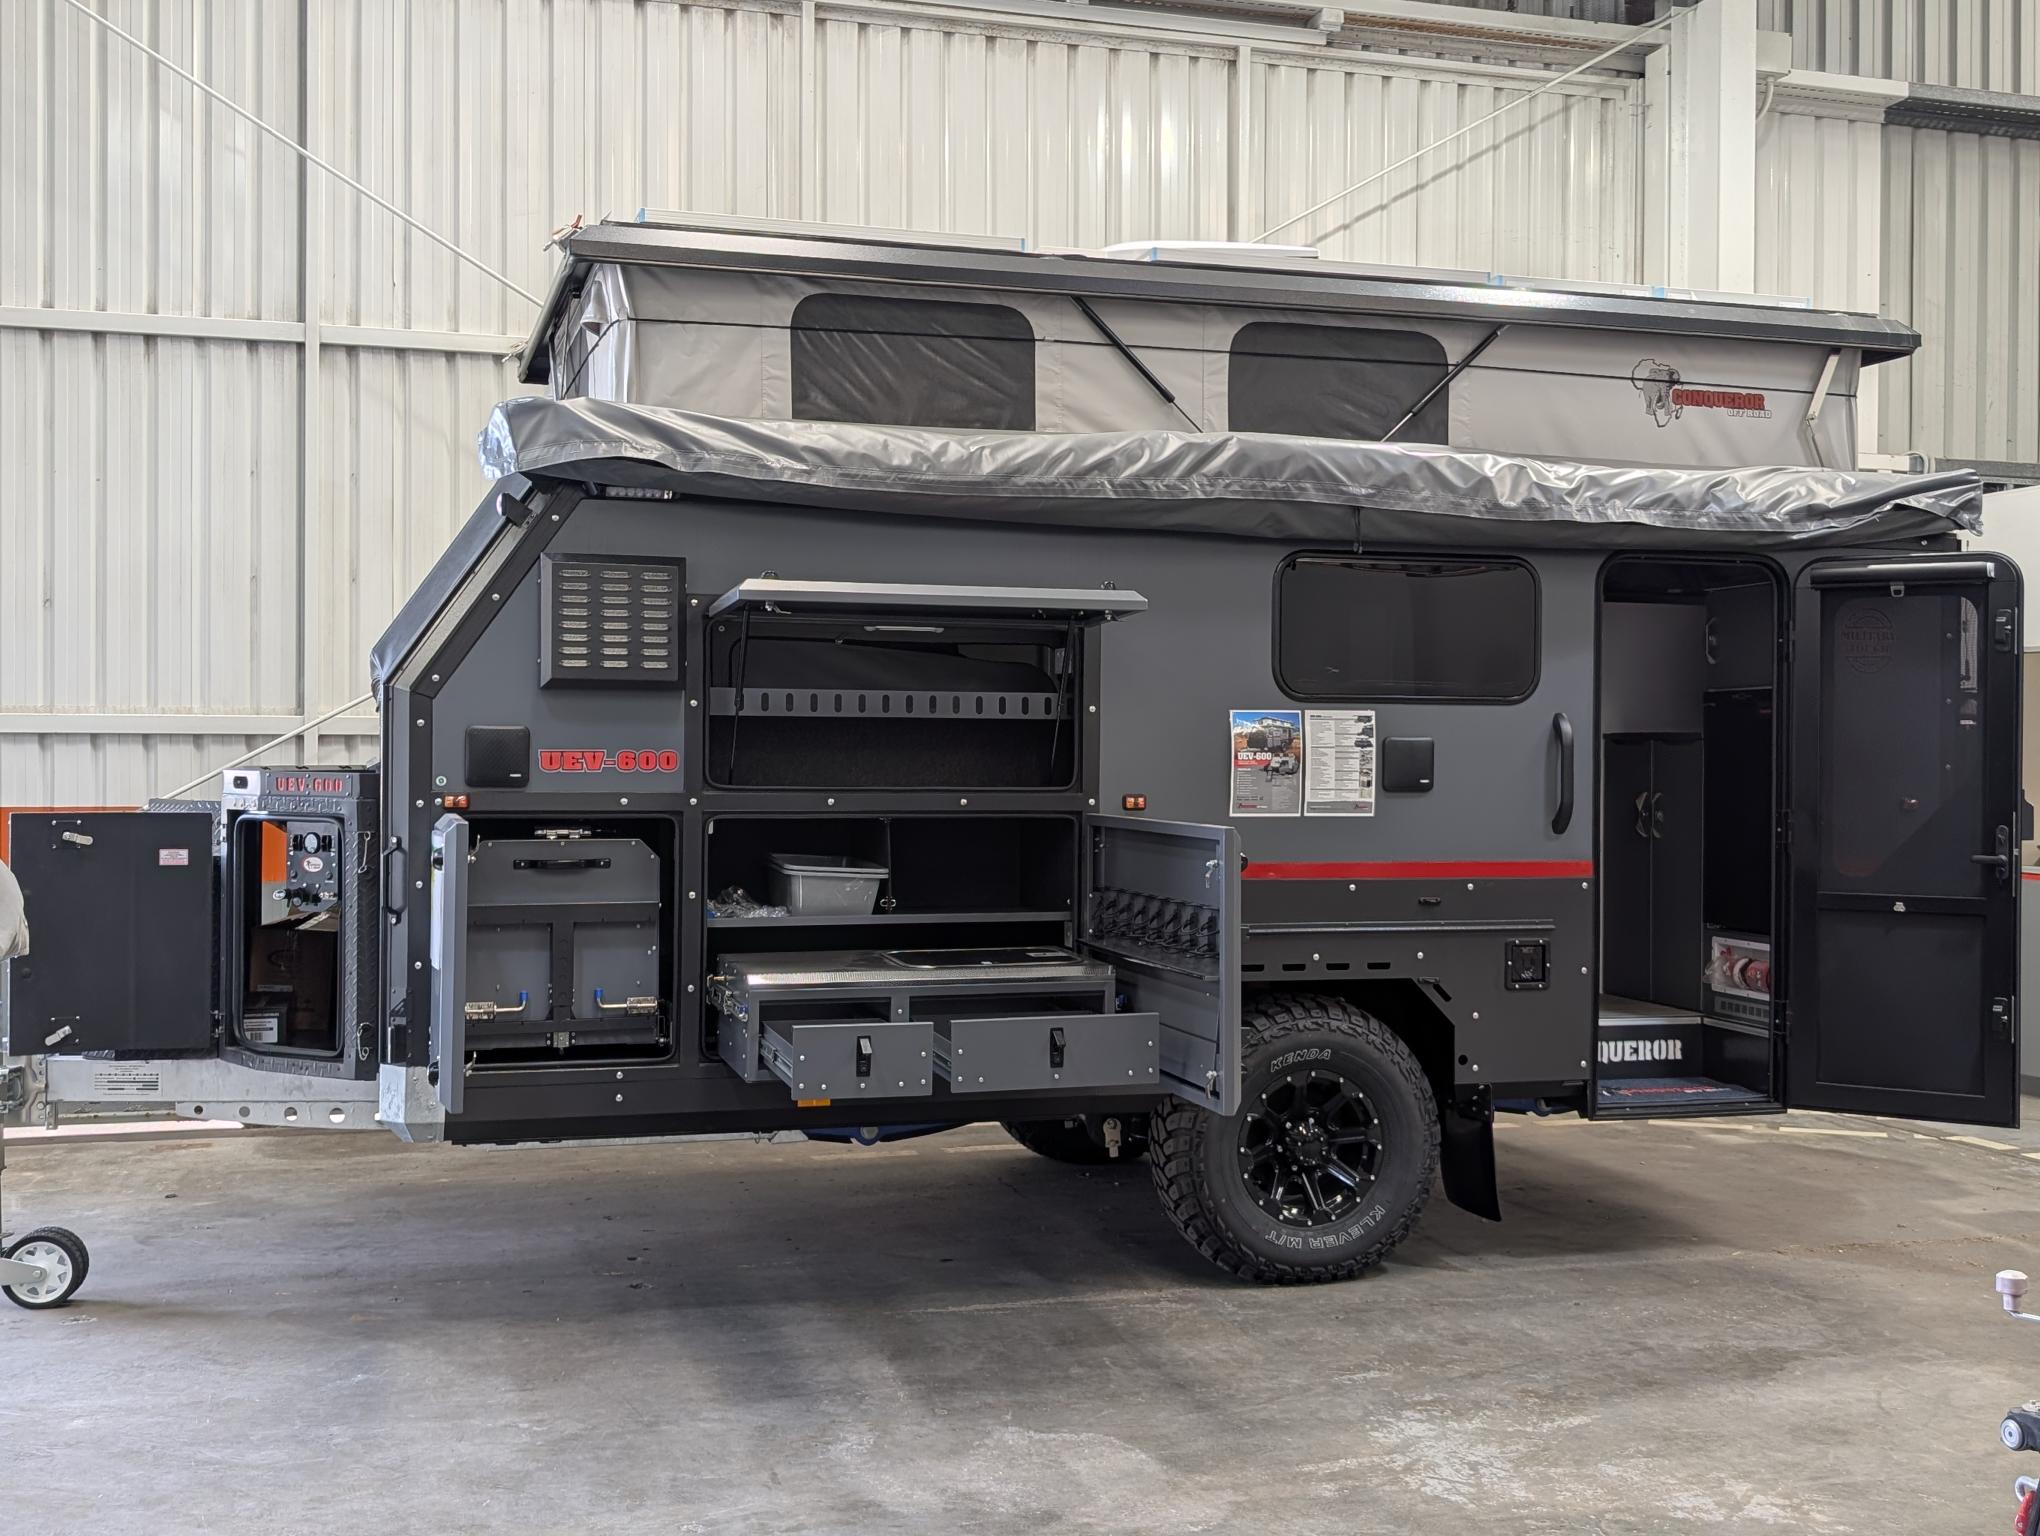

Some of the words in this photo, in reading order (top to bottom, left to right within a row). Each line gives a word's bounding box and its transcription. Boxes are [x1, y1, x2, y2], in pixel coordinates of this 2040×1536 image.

[1672, 388, 1765, 411] CONQUEROR
[1727, 408, 1745, 417] OFF
[538, 749, 680, 773] UEV-600
[1237, 751, 1272, 761] UEV-600
[275, 776, 343, 793] UEV-600
[1270, 1048, 1331, 1073] KENDA
[1309, 1204, 1386, 1250] KLEVER
[1265, 1230, 1302, 1249] M/T
